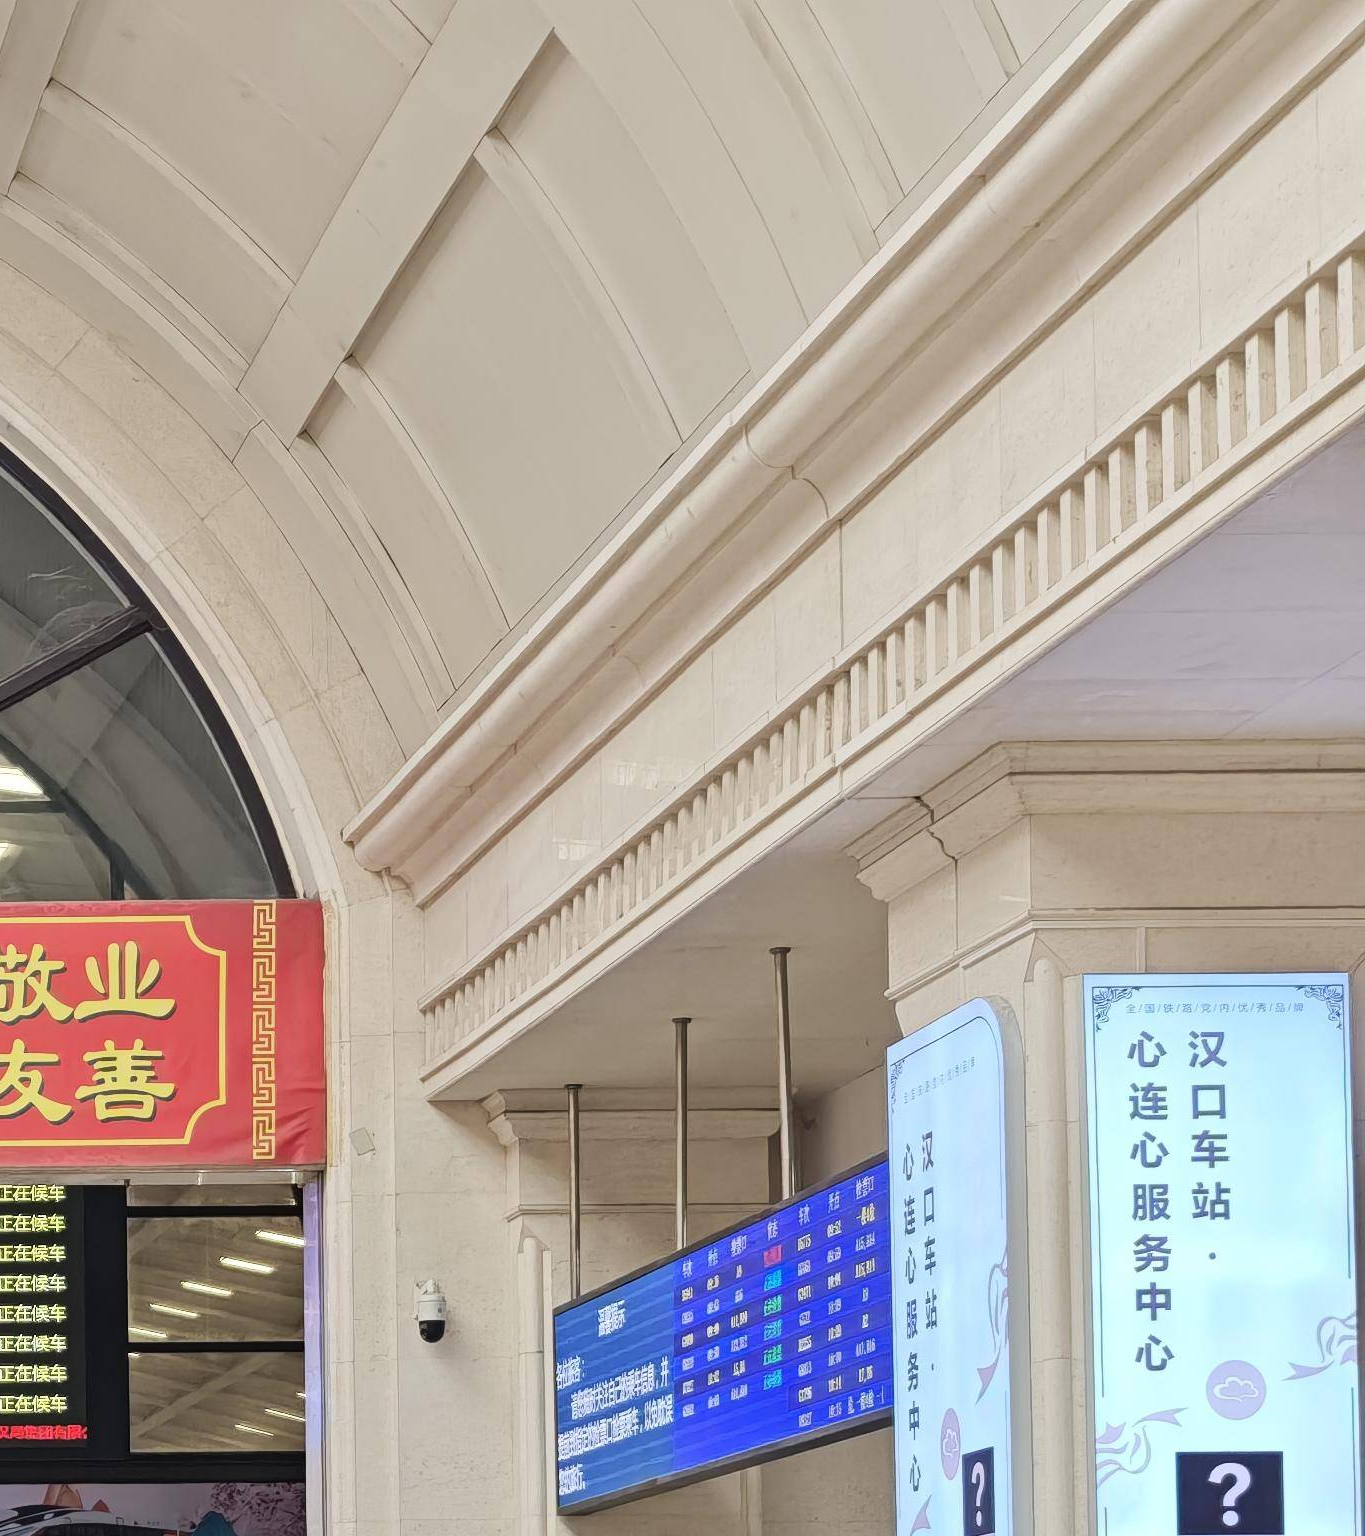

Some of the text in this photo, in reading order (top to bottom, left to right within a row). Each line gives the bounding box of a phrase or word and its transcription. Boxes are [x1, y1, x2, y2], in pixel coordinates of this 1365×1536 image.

[903, 1143, 921, 1492] 心连心服务中心
[1128, 1031, 1175, 1372] 心连心服务中心
